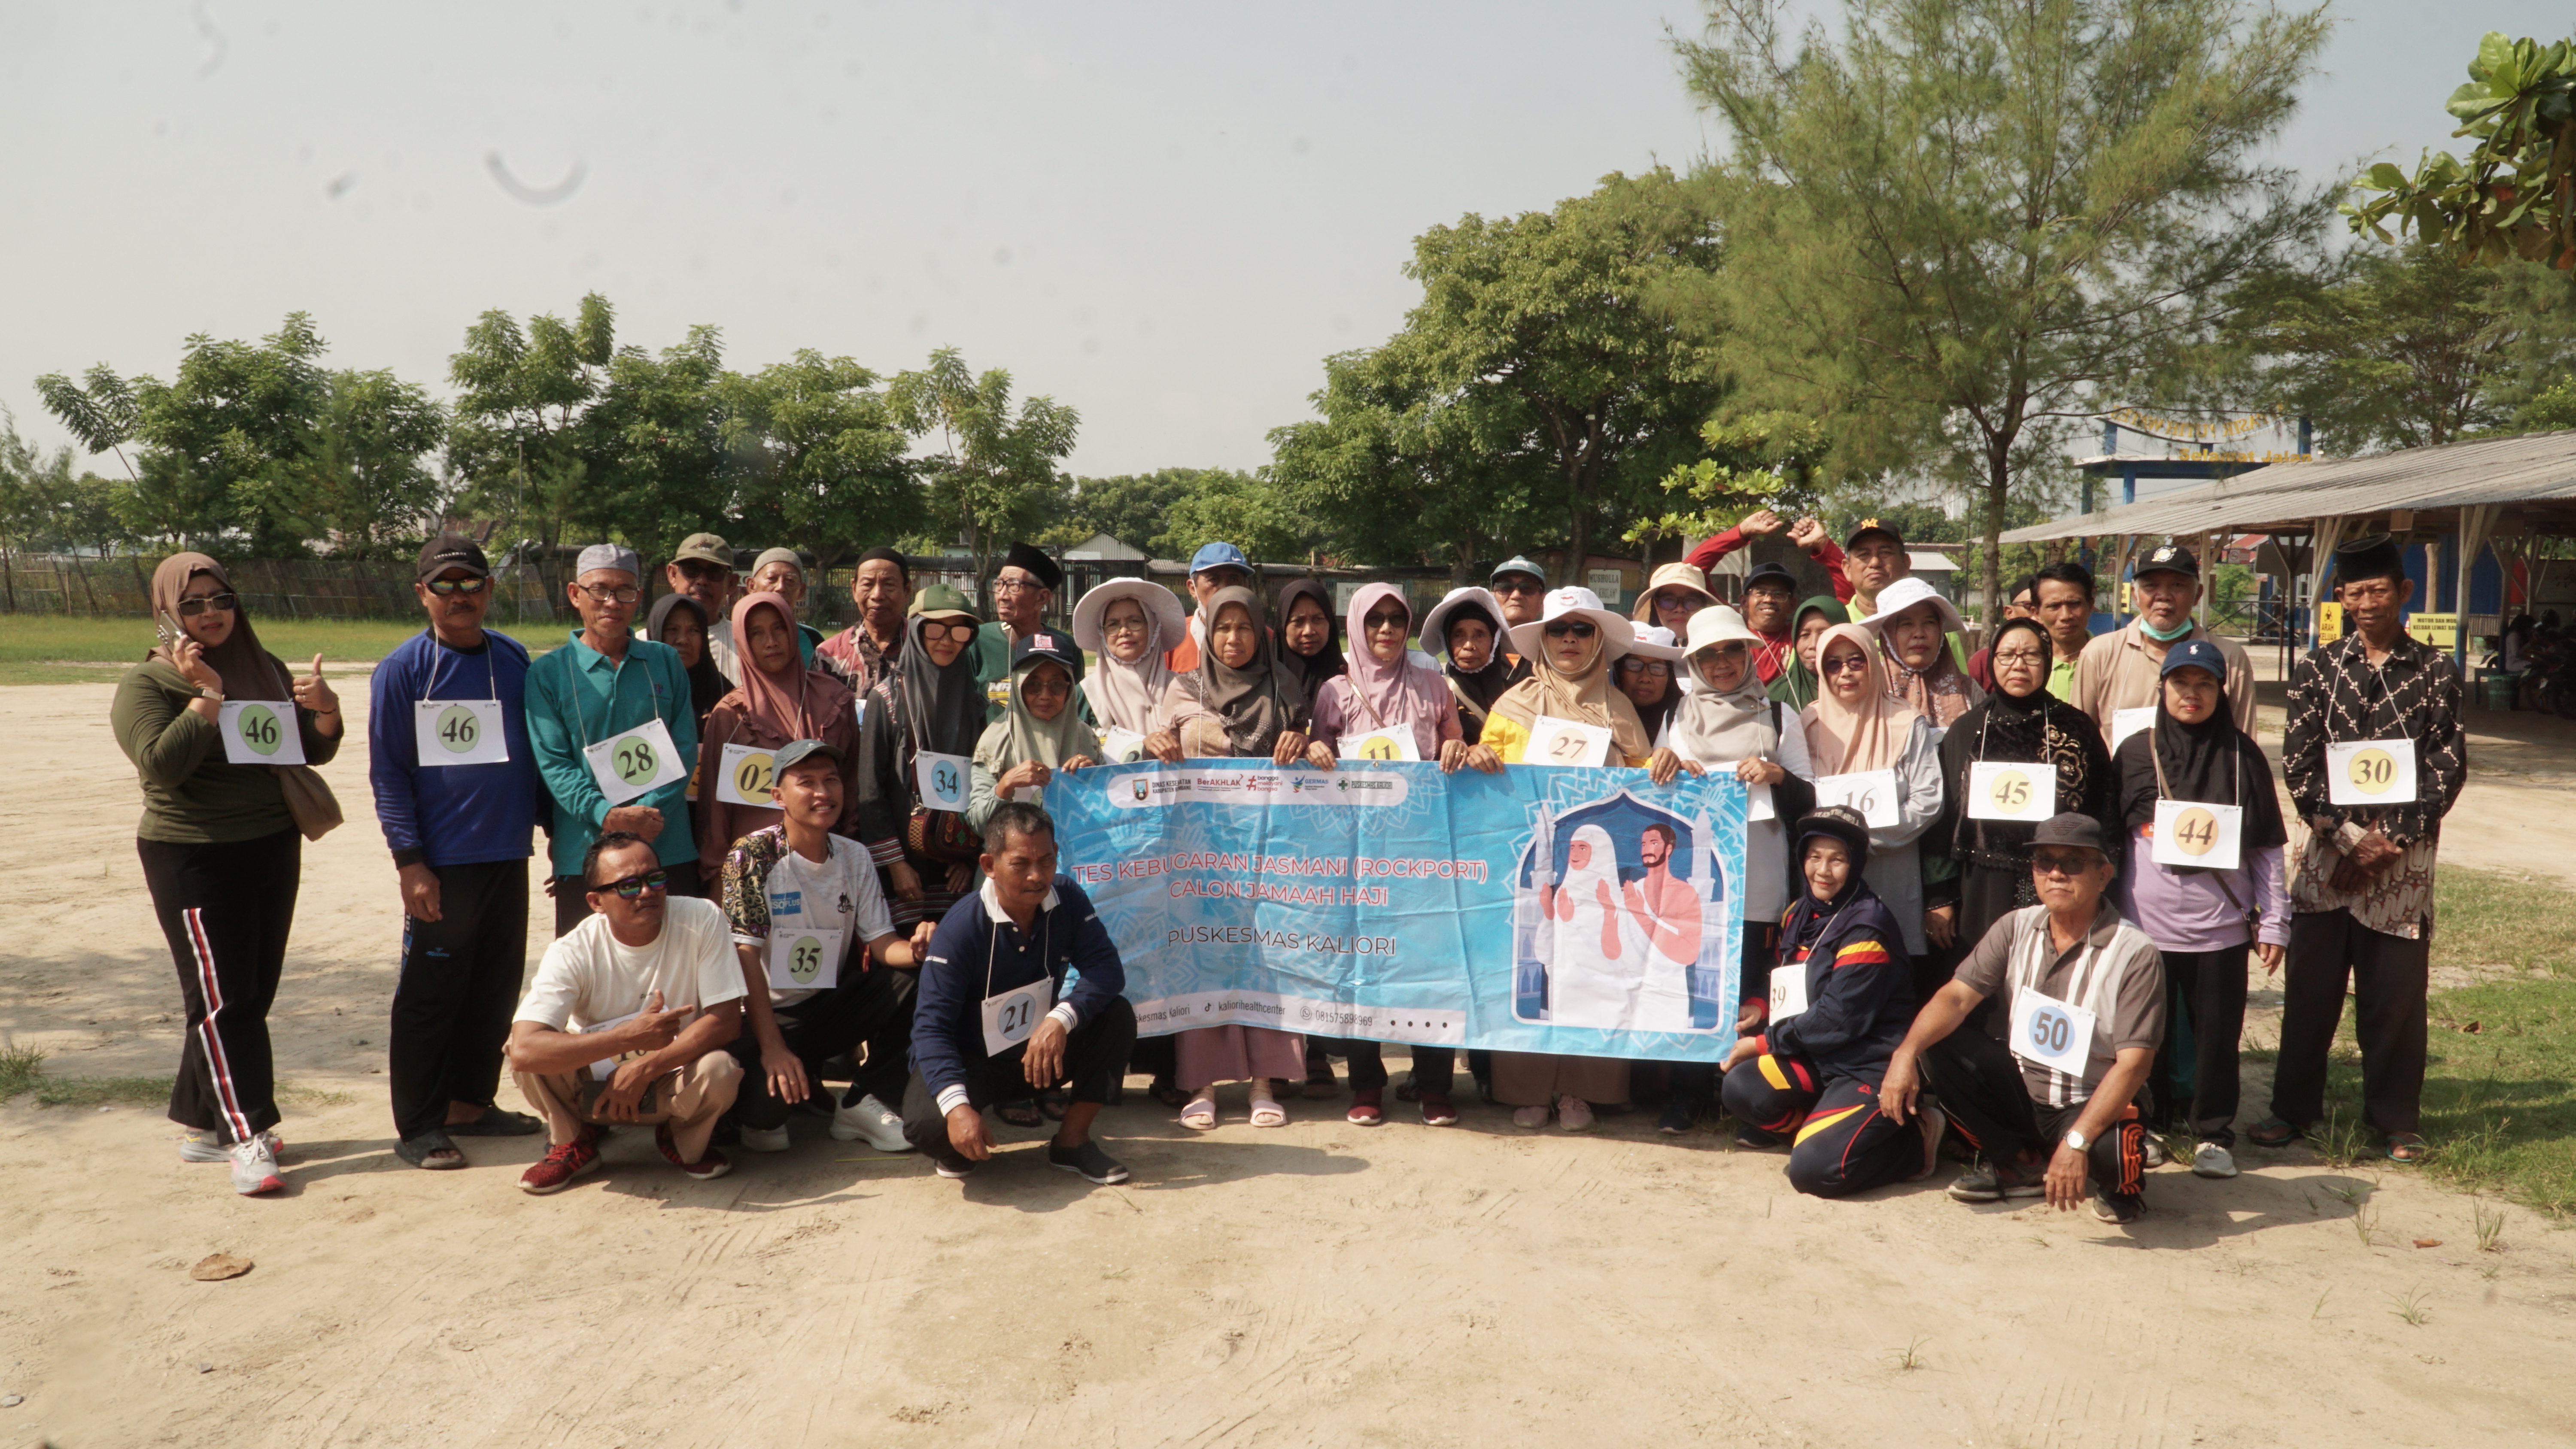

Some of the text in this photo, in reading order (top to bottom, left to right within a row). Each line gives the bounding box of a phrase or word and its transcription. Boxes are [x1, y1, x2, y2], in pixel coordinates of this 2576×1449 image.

[2179, 448, 2312, 463] Selamat Jalan
[245, 716, 276, 744] 46
[442, 716, 476, 742] 46
[1551, 737, 1587, 759] 27
[619, 743, 653, 779] 28
[2354, 758, 2391, 784] 30
[936, 770, 957, 794] 34
[1197, 775, 1242, 786] BerAKHLAK
[1995, 780, 2030, 804] 45
[1845, 787, 1876, 812] 16
[2178, 818, 2214, 845] 44
[1072, 852, 1488, 883] TES KEBUGARAN JASMANI (ROCKPORT)
[1170, 881, 1388, 905] CALON JAMAAH HAJI
[1168, 927, 1396, 955] PUSKESMAS KALIORI
[791, 947, 821, 973] 35
[1218, 1000, 1285, 1016] kaliorihealthcenter
[1770, 986, 1786, 1011] 39
[1003, 1000, 1029, 1034] 21
[1136, 1004, 1190, 1023] skesmas Kaliori
[1315, 1010, 1373, 1026] 081575898969
[2034, 1012, 2069, 1051] 50
